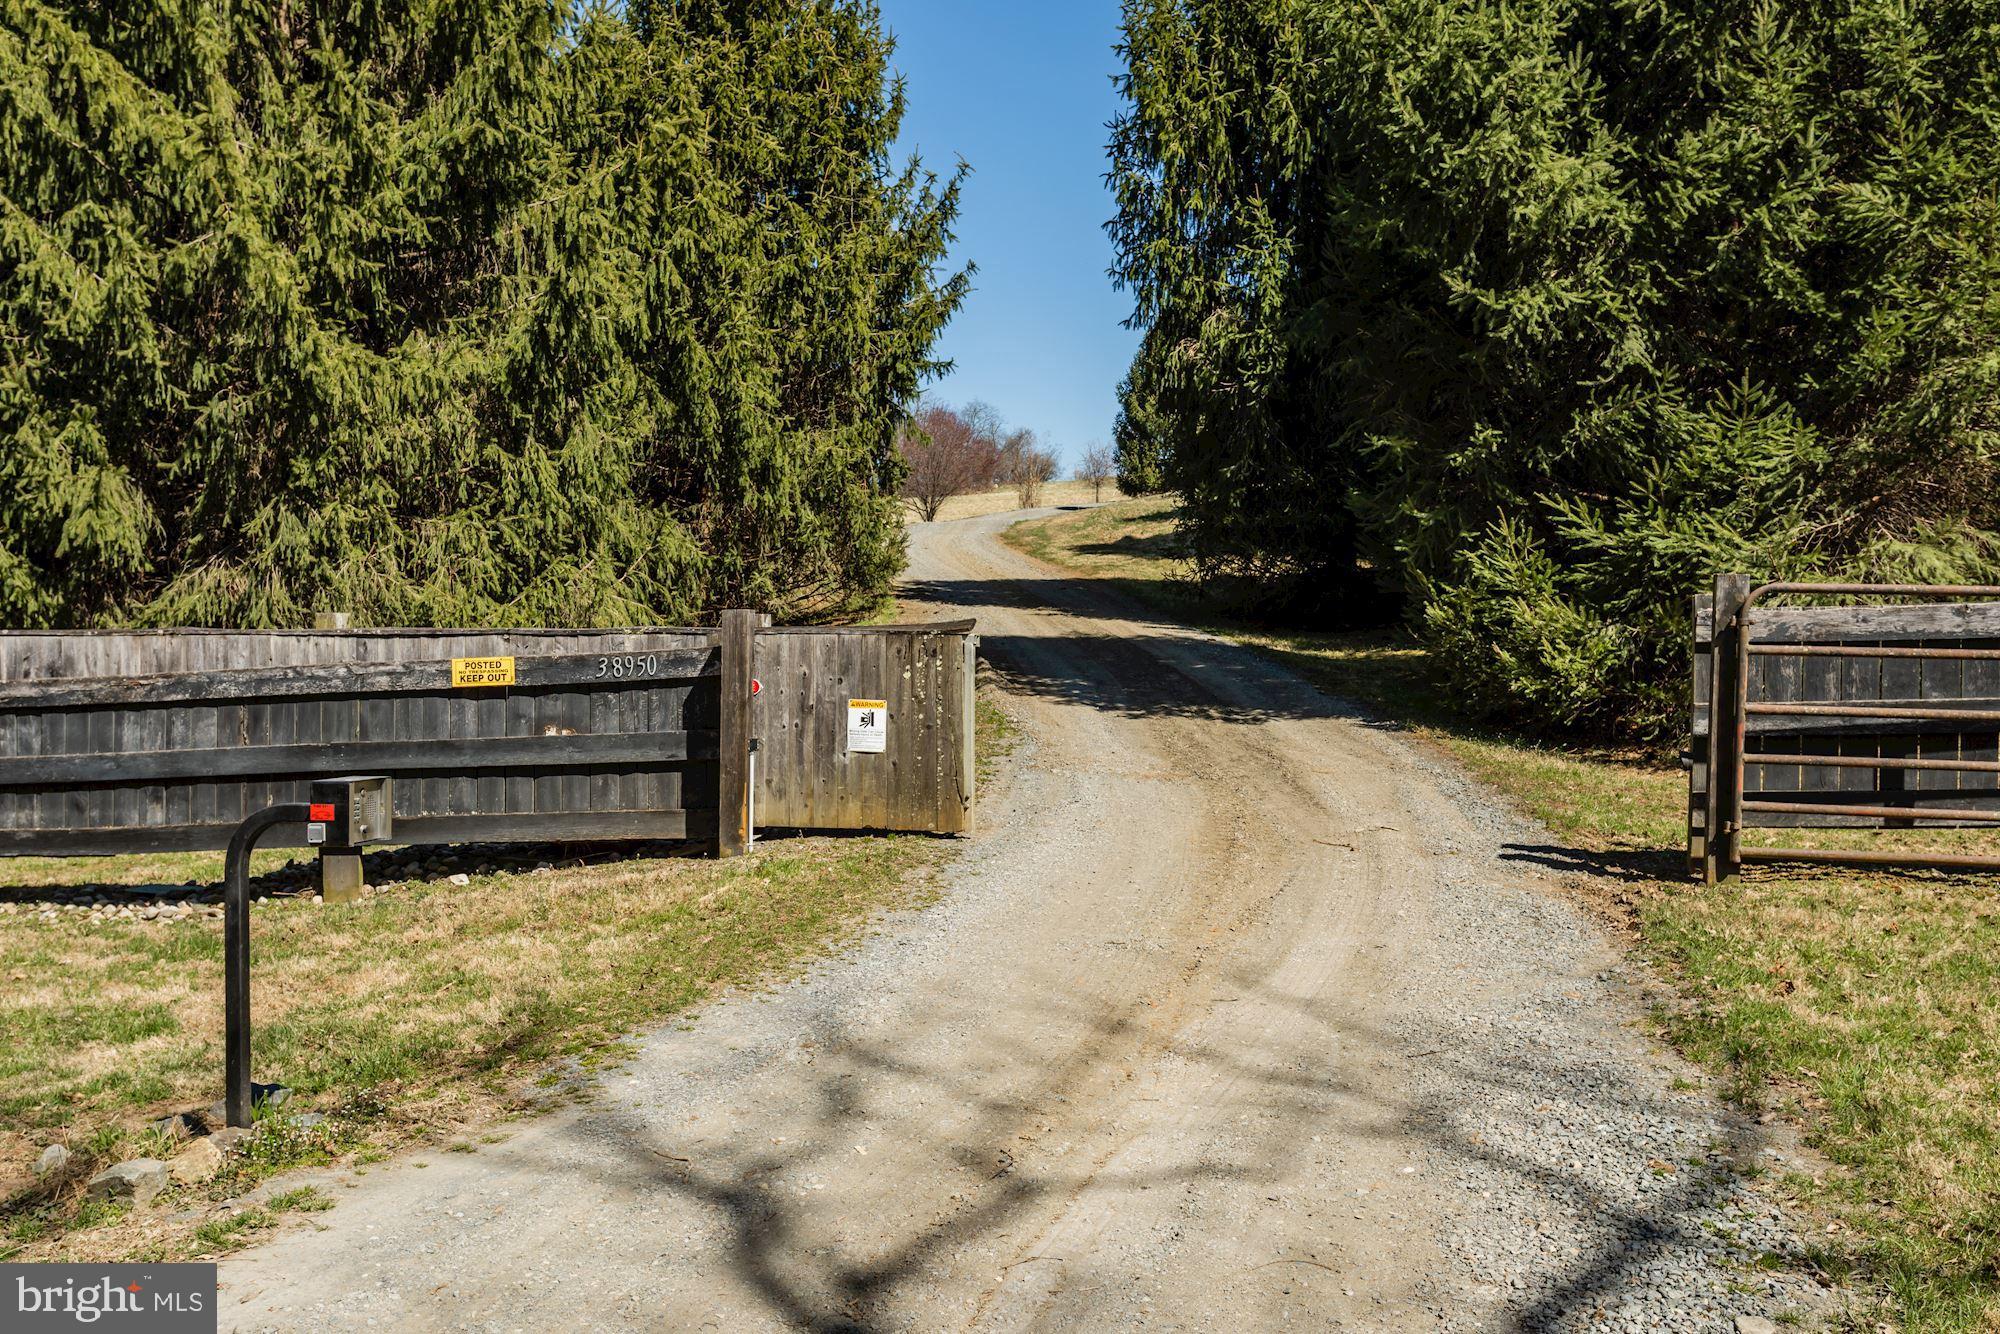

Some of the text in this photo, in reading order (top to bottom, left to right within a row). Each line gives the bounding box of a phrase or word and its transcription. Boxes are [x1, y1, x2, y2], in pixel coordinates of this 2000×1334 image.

[465, 661, 502, 669] POSTED
[596, 655, 657, 678] 38950
[460, 673, 507, 683] KEEP OUT
